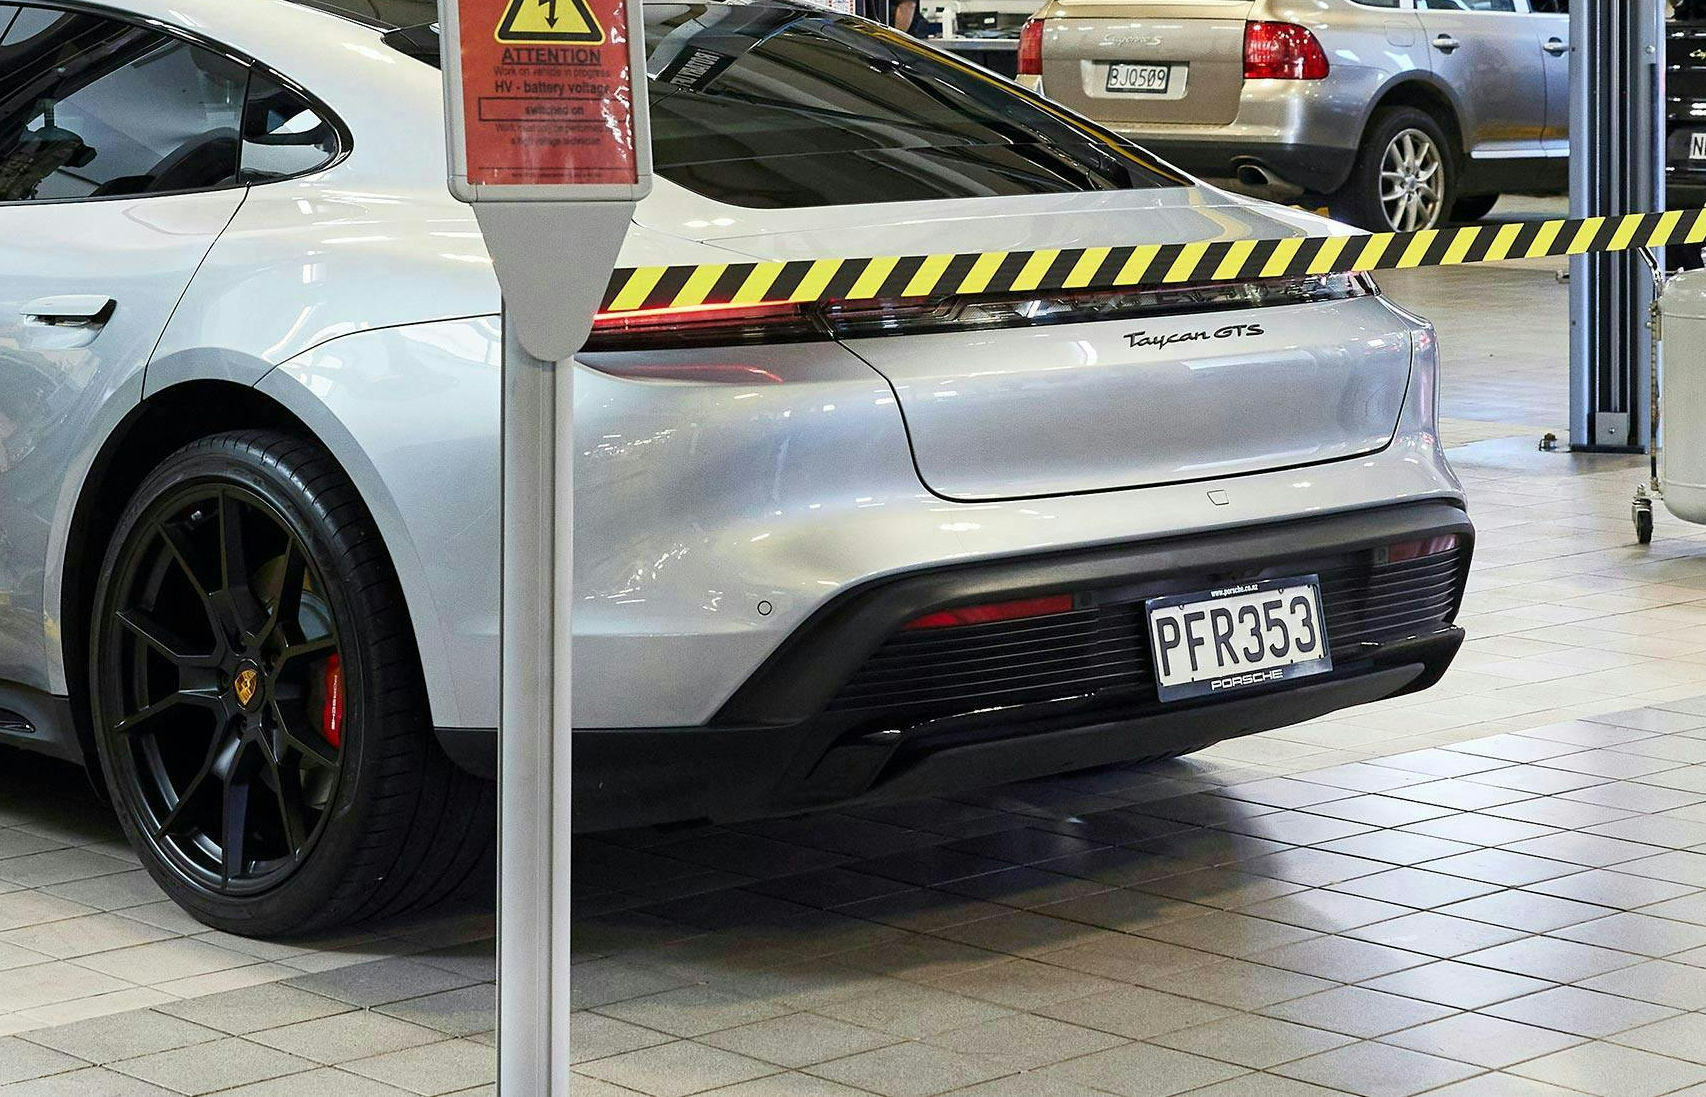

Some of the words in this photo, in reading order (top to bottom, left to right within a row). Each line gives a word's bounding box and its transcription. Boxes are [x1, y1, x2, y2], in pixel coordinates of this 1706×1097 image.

[501, 47, 601, 64] ATTENTION
[1109, 67, 1166, 88] BJQ509
[495, 80, 512, 93] HV
[524, 81, 564, 96] battery
[525, 106, 568, 115] switched
[572, 107, 585, 115] on
[1123, 330, 1210, 350] Taycan
[1213, 323, 1265, 339] GTS
[1210, 583, 1259, 598] www.porsche.co.nz
[1155, 595, 1316, 677] PFR353
[1211, 668, 1284, 691] PORSCHE
